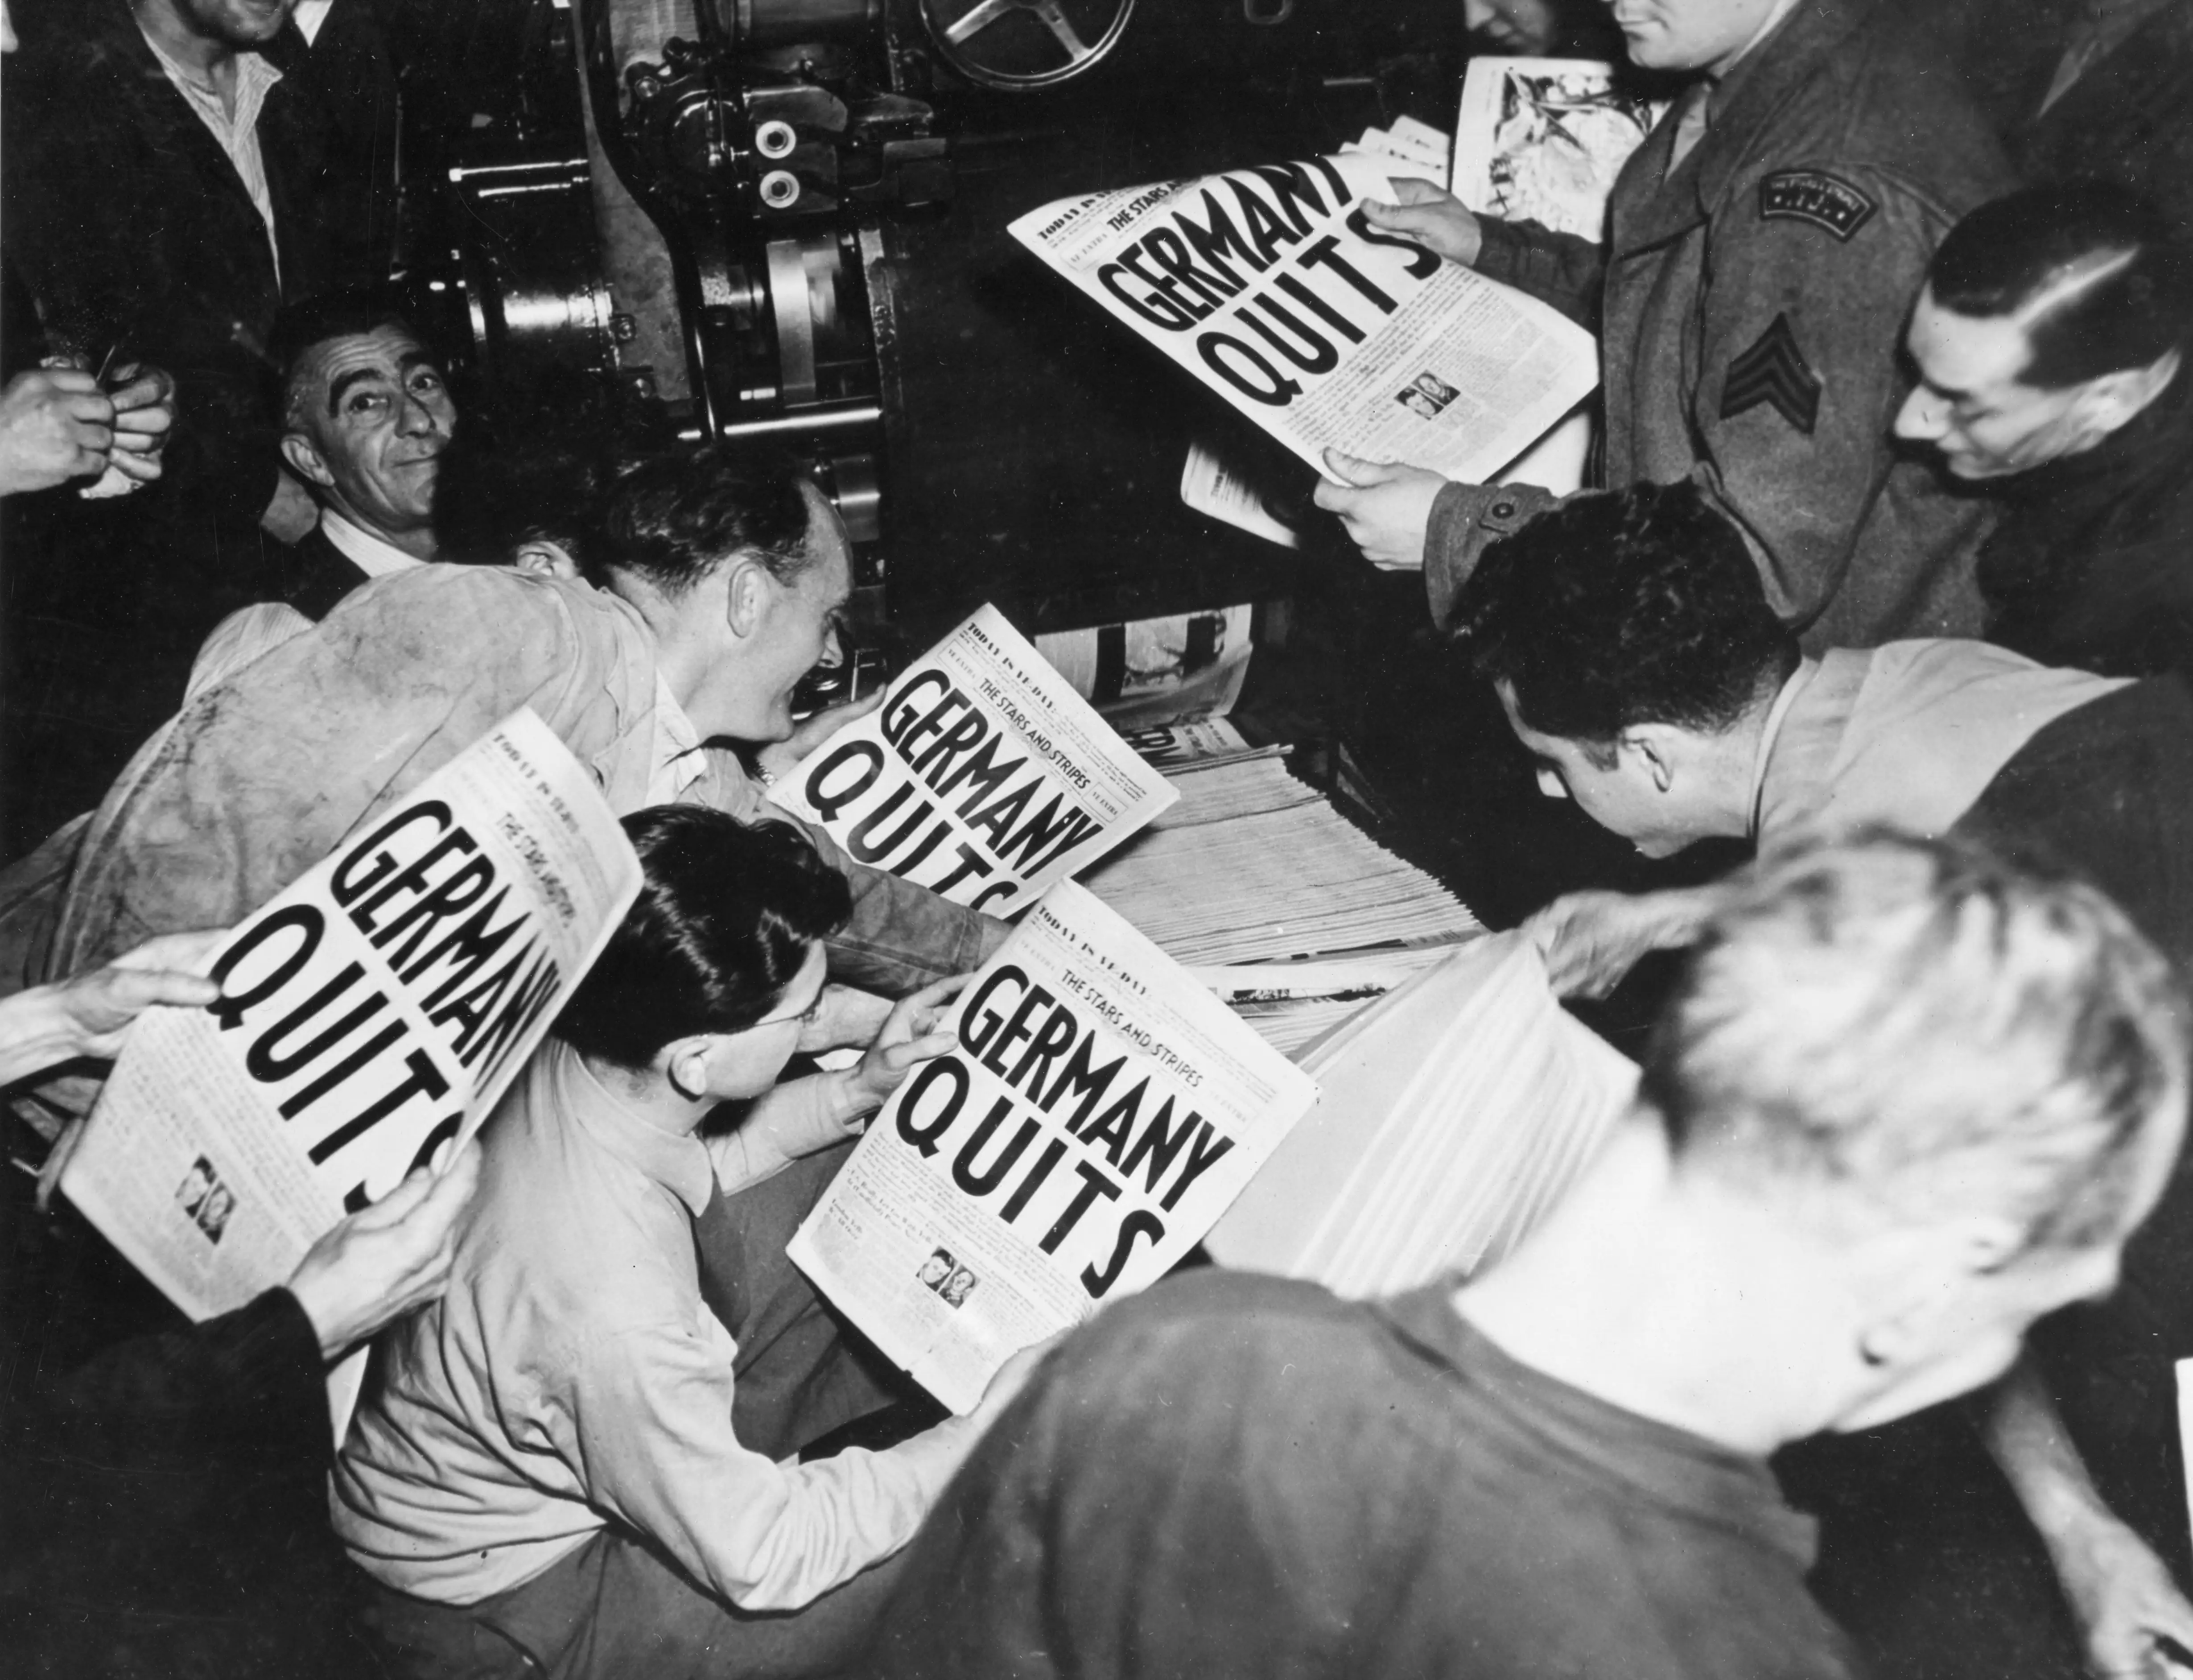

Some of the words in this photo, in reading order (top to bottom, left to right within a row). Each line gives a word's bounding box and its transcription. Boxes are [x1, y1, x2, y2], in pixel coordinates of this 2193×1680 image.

[1038, 208, 1080, 239] TODAY
[1107, 209, 1134, 231] THE
[1129, 187, 1169, 215] STARS
[1196, 207, 1442, 406] QUITS
[968, 622, 1000, 656] TODAY
[882, 669, 1104, 880] GERMANY
[980, 678, 1001, 701] THE
[996, 697, 1031, 730] STARS
[1026, 729, 1051, 752] AND
[1049, 751, 1091, 789] STRIPES
[331, 800, 561, 1099] GERMANY
[1039, 905, 1076, 942] TODAY
[203, 904, 464, 1215] QUITS
[959, 965, 1235, 1213] GERMANY
[1062, 969, 1087, 994] THE
[1084, 988, 1124, 1025] STARS
[1121, 1023, 1152, 1048] AND
[1150, 1043, 1204, 1088] STRIPES
[896, 1055, 1165, 1299] QUITS
